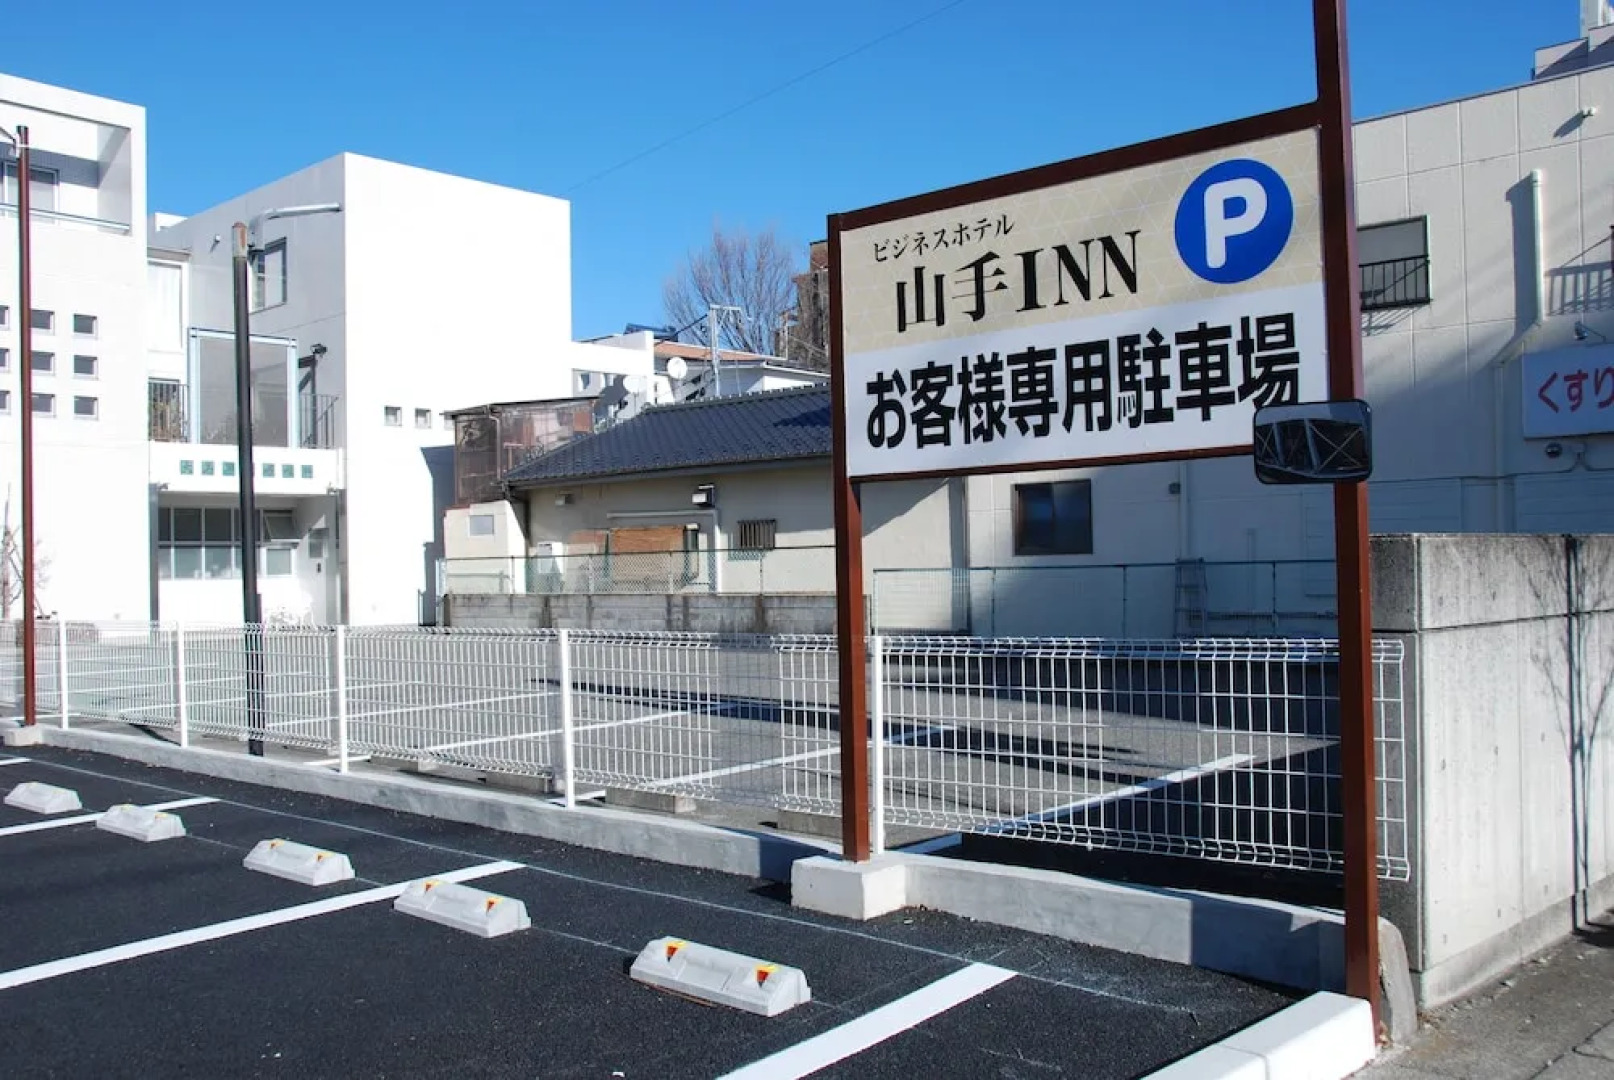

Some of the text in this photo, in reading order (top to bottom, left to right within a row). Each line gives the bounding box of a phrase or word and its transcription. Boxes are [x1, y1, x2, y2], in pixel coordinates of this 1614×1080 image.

[873, 214, 1013, 263] ビジネスホテル
[1204, 178, 1267, 269] P
[866, 313, 1300, 449] お客様専用駐車場
[1538, 366, 1614, 413] くすり
